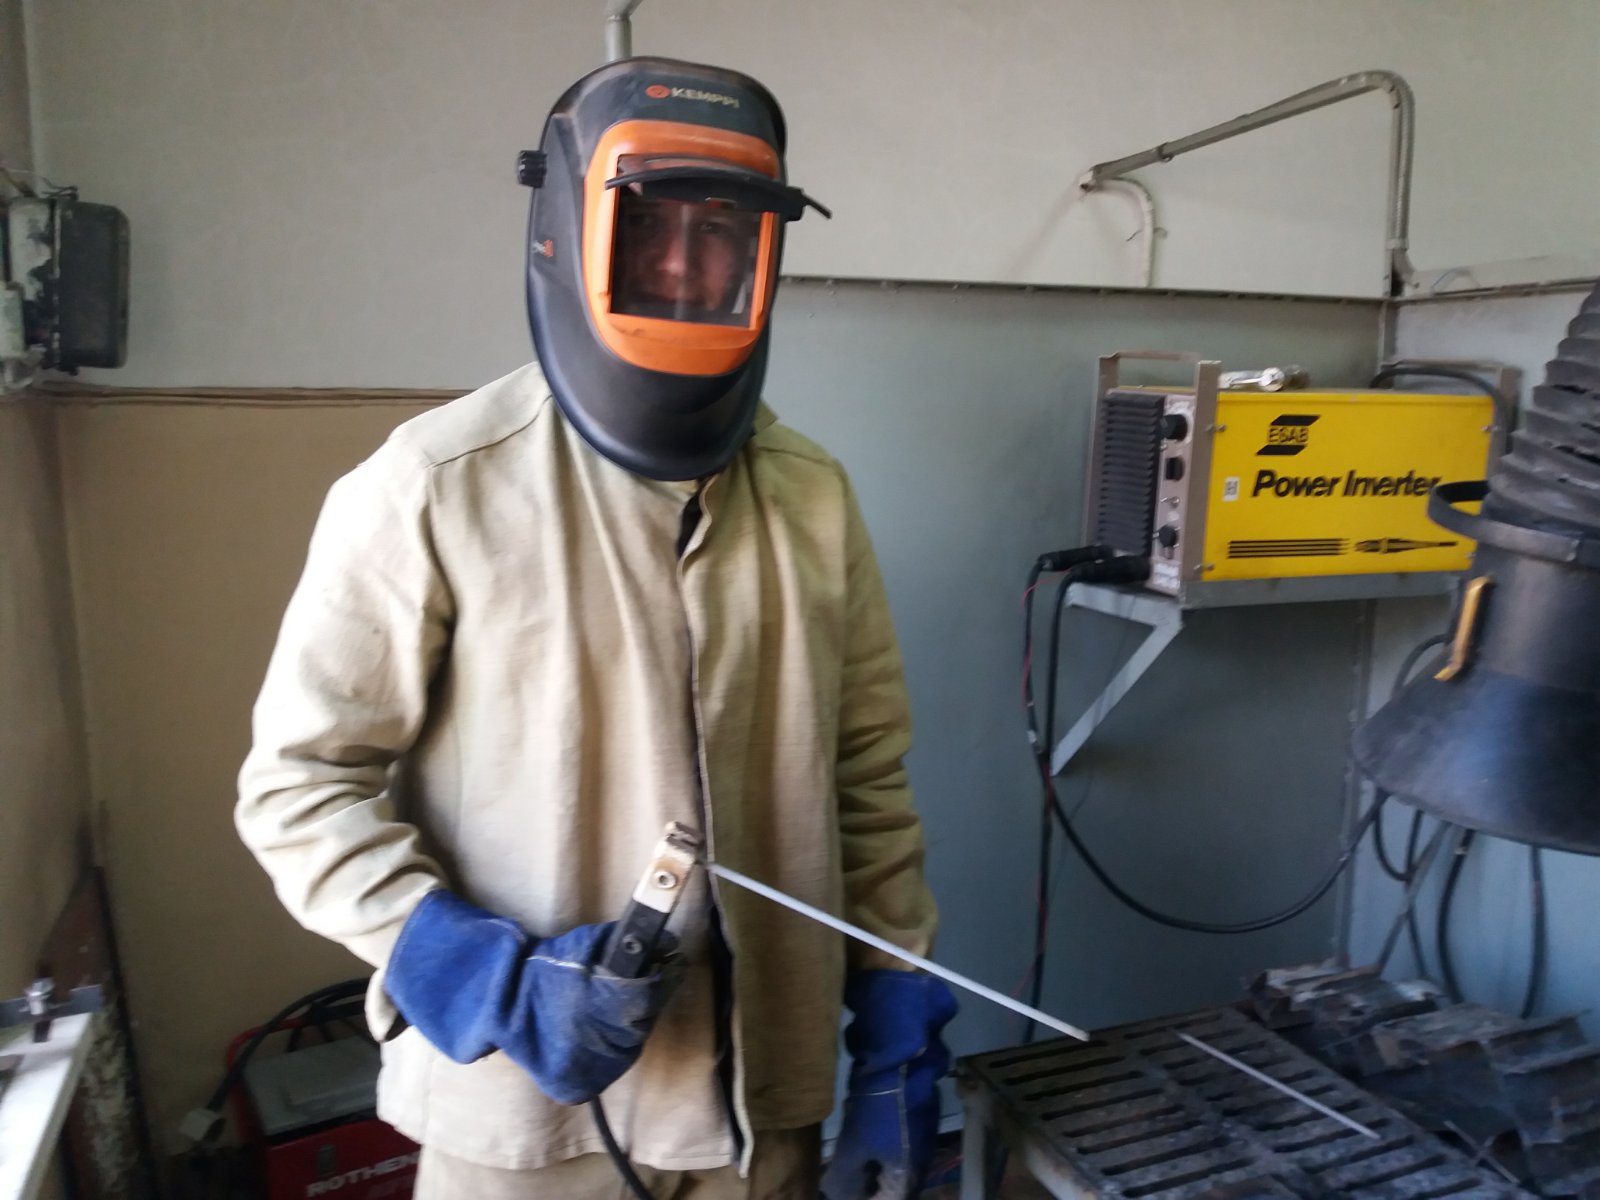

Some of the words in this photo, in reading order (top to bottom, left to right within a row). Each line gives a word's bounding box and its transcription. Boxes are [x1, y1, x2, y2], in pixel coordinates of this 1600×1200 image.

[671, 87, 740, 108] KEMPPI
[1267, 427, 1309, 443] ESAB
[1252, 469, 1341, 498] Power
